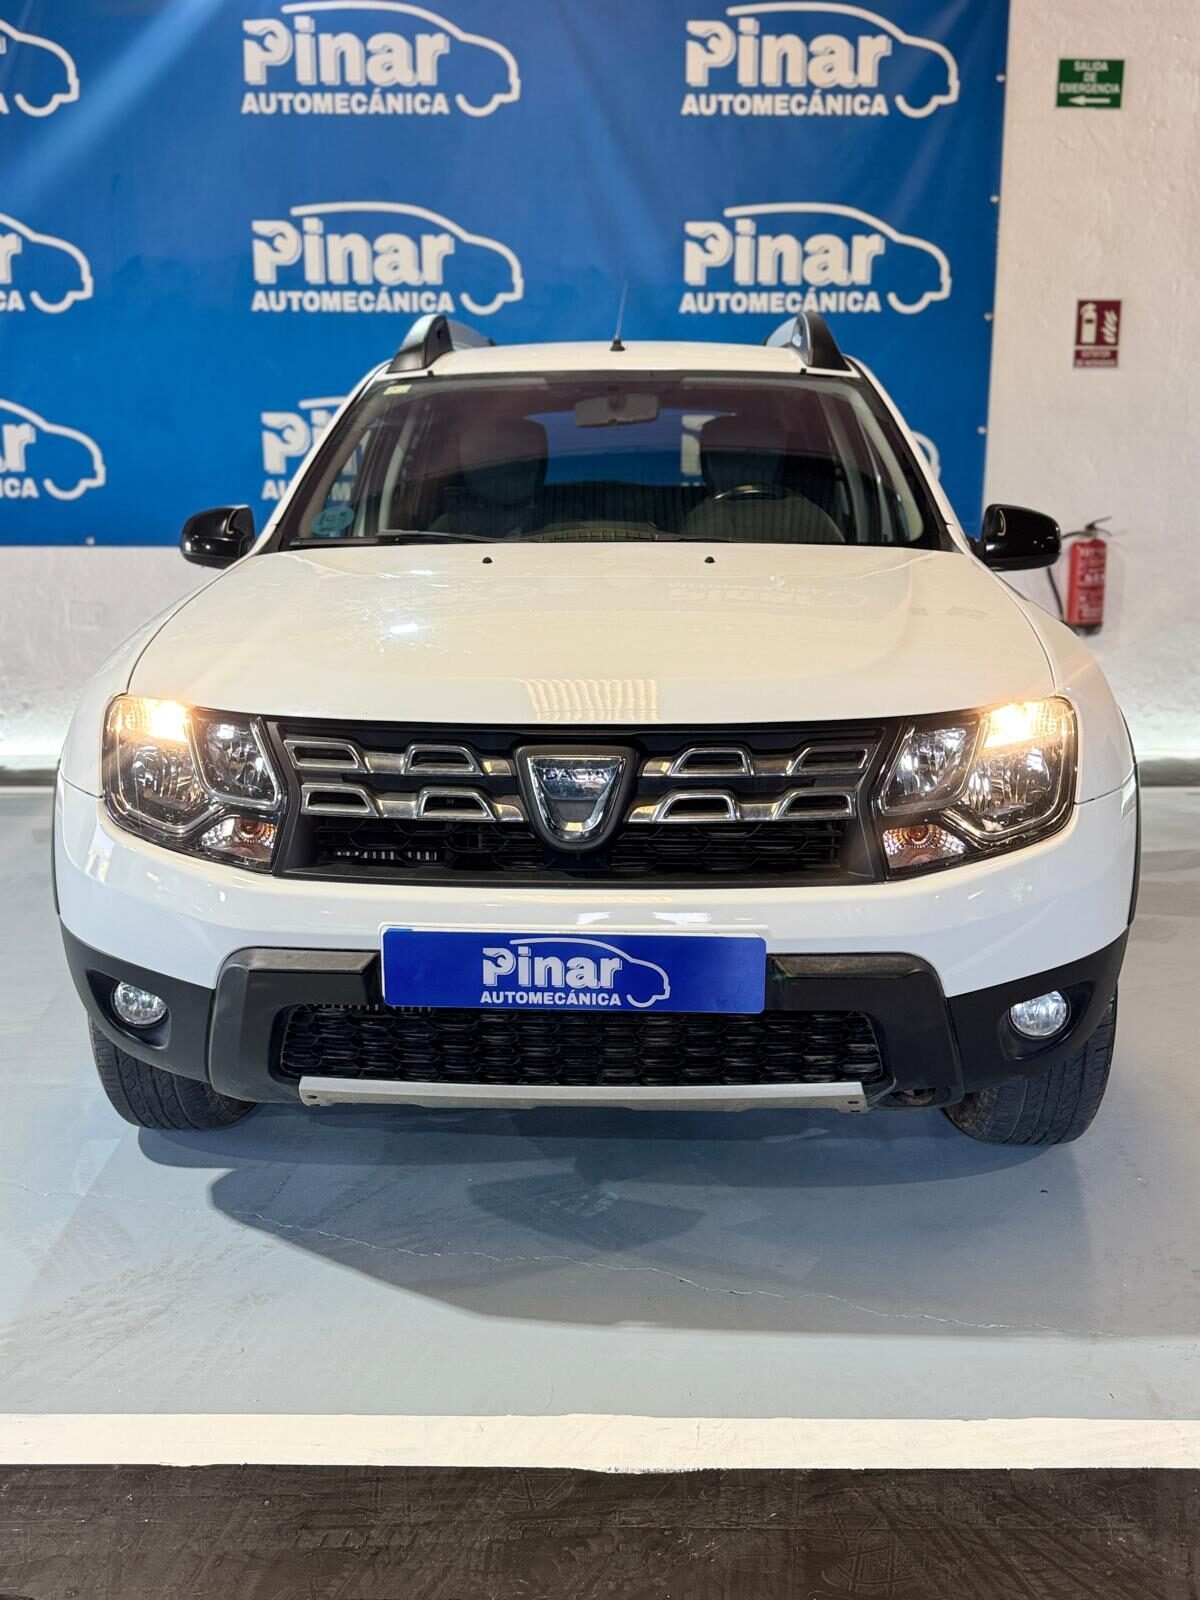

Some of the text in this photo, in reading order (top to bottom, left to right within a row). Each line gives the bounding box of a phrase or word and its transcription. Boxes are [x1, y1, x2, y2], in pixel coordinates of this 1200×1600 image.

[243, 16, 450, 86] Pinar
[686, 17, 892, 88] Pinar
[241, 88, 450, 114] AUTOMECÁNICA
[681, 88, 889, 116] AUTOMECÁNICA
[252, 217, 455, 285] Pinar
[684, 218, 885, 286] Pinar
[251, 286, 455, 313] AUTOMECÁNICA
[679, 286, 881, 314] AUTOMECÁNICA
[543, 768, 610, 782] DACIA
[483, 946, 622, 989] Pinar
[480, 990, 622, 1006] AUTOMECÁNICA
